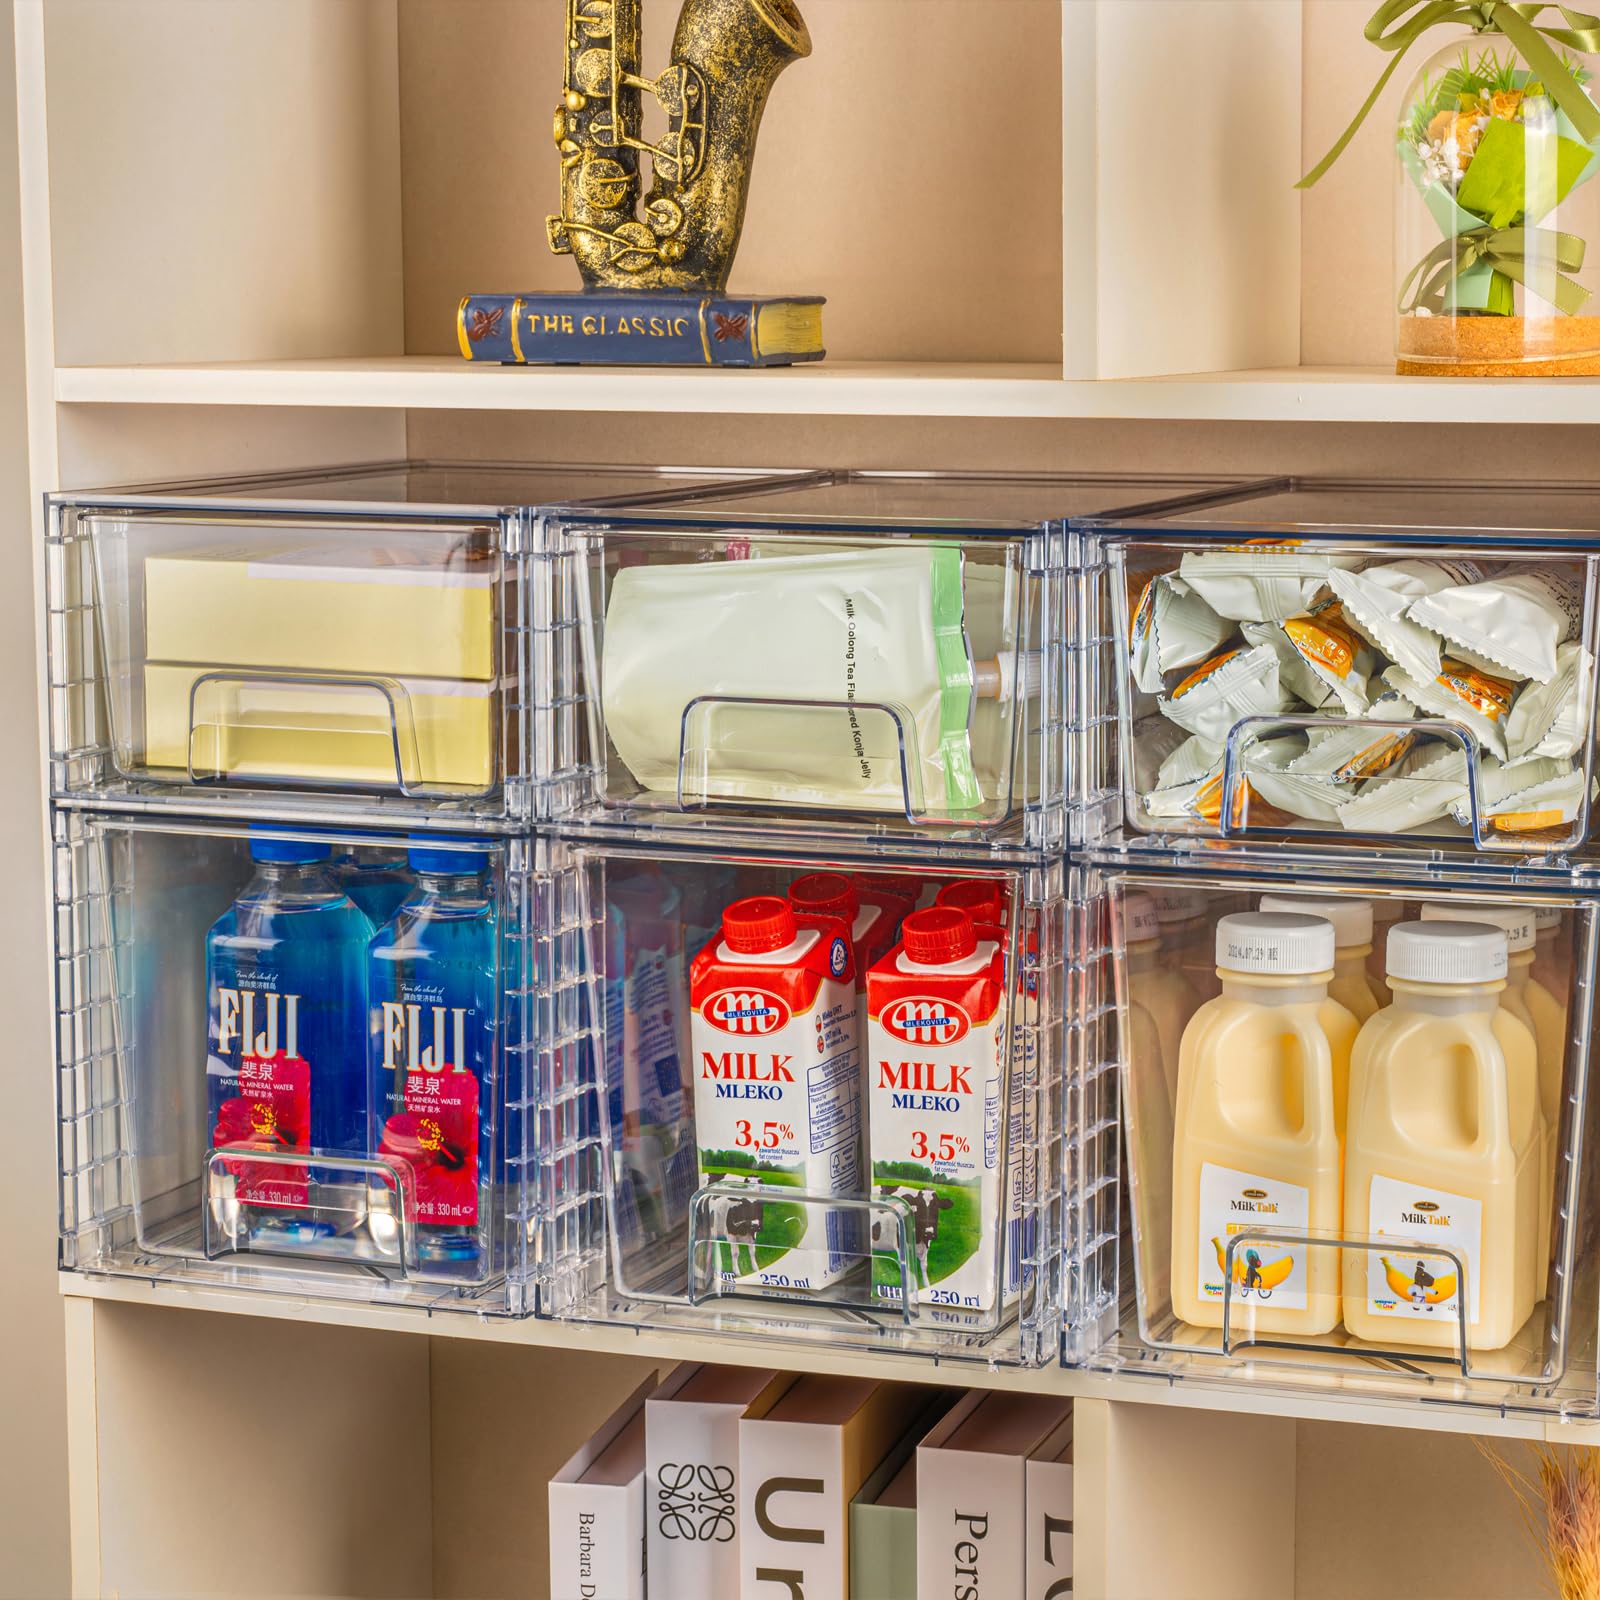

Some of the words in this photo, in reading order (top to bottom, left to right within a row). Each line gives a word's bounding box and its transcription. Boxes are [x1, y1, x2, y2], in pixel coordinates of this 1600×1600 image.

[845, 598, 856, 620] Milk
[845, 622, 857, 660] Oolong
[847, 662, 856, 680] Tea
[860, 760, 872, 779] Jelly
[217, 987, 302, 1060] FIJI
[726, 1009, 768, 1019] MLEKOVITA
[904, 1019, 948, 1029] MLEKOVITA
[381, 1001, 468, 1074] FIJI
[241, 1061, 274, 1081] 斐泉
[701, 1051, 796, 1083] MILK
[219, 1078, 246, 1088] NATURAL
[246, 1081, 272, 1090] MINERAL
[273, 1083, 294, 1092] WATER
[407, 1075, 441, 1096] 斐泉
[877, 1061, 973, 1095] MILK
[242, 1088, 274, 1099] 天然矿泉水
[386, 1093, 411, 1103] NATURAL
[412, 1096, 440, 1105] MINERAL
[440, 1098, 462, 1107] WATER
[715, 1083, 783, 1101] MLEKO
[408, 1103, 441, 1114] 天然矿泉水
[891, 1093, 960, 1113] MLEKO
[735, 1119, 794, 1152] 3,5%
[910, 1131, 971, 1164] 3,5%
[760, 1273, 790, 1287] 250
[794, 1278, 810, 1288] ml
[930, 1289, 960, 1305] 250
[579, 1512, 596, 1578] Barbara
[580, 1584, 597, 1600] D
